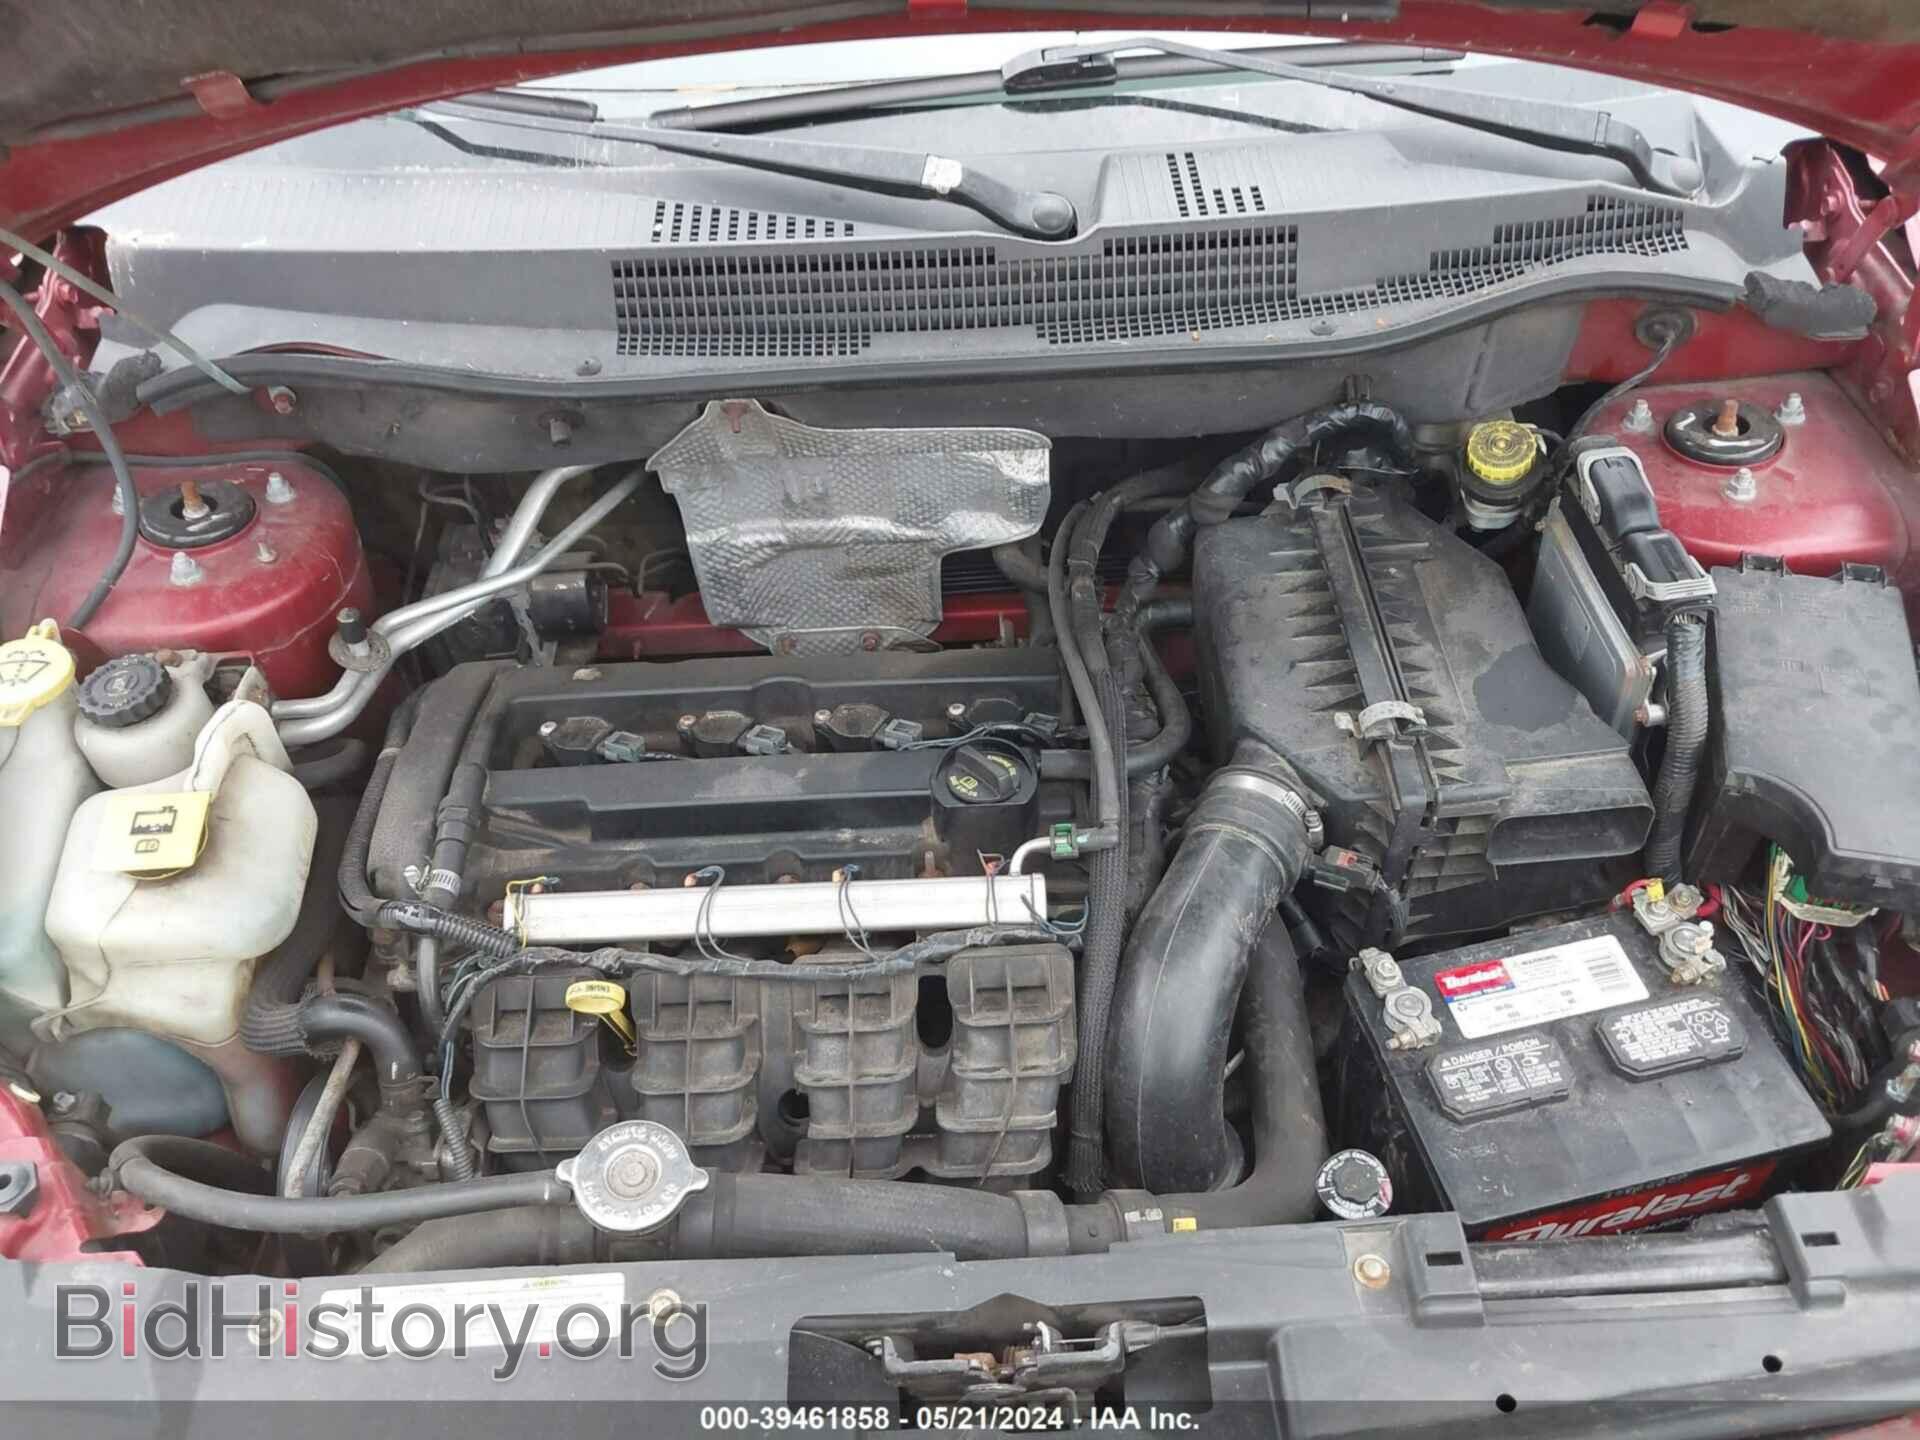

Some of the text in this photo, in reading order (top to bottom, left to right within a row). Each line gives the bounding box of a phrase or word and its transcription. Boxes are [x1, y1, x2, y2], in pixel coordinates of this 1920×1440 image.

[1450, 1049, 1493, 1065] DANGER
[1502, 1038, 1540, 1052] POISON
[1502, 1173, 1751, 1240] Duralast
